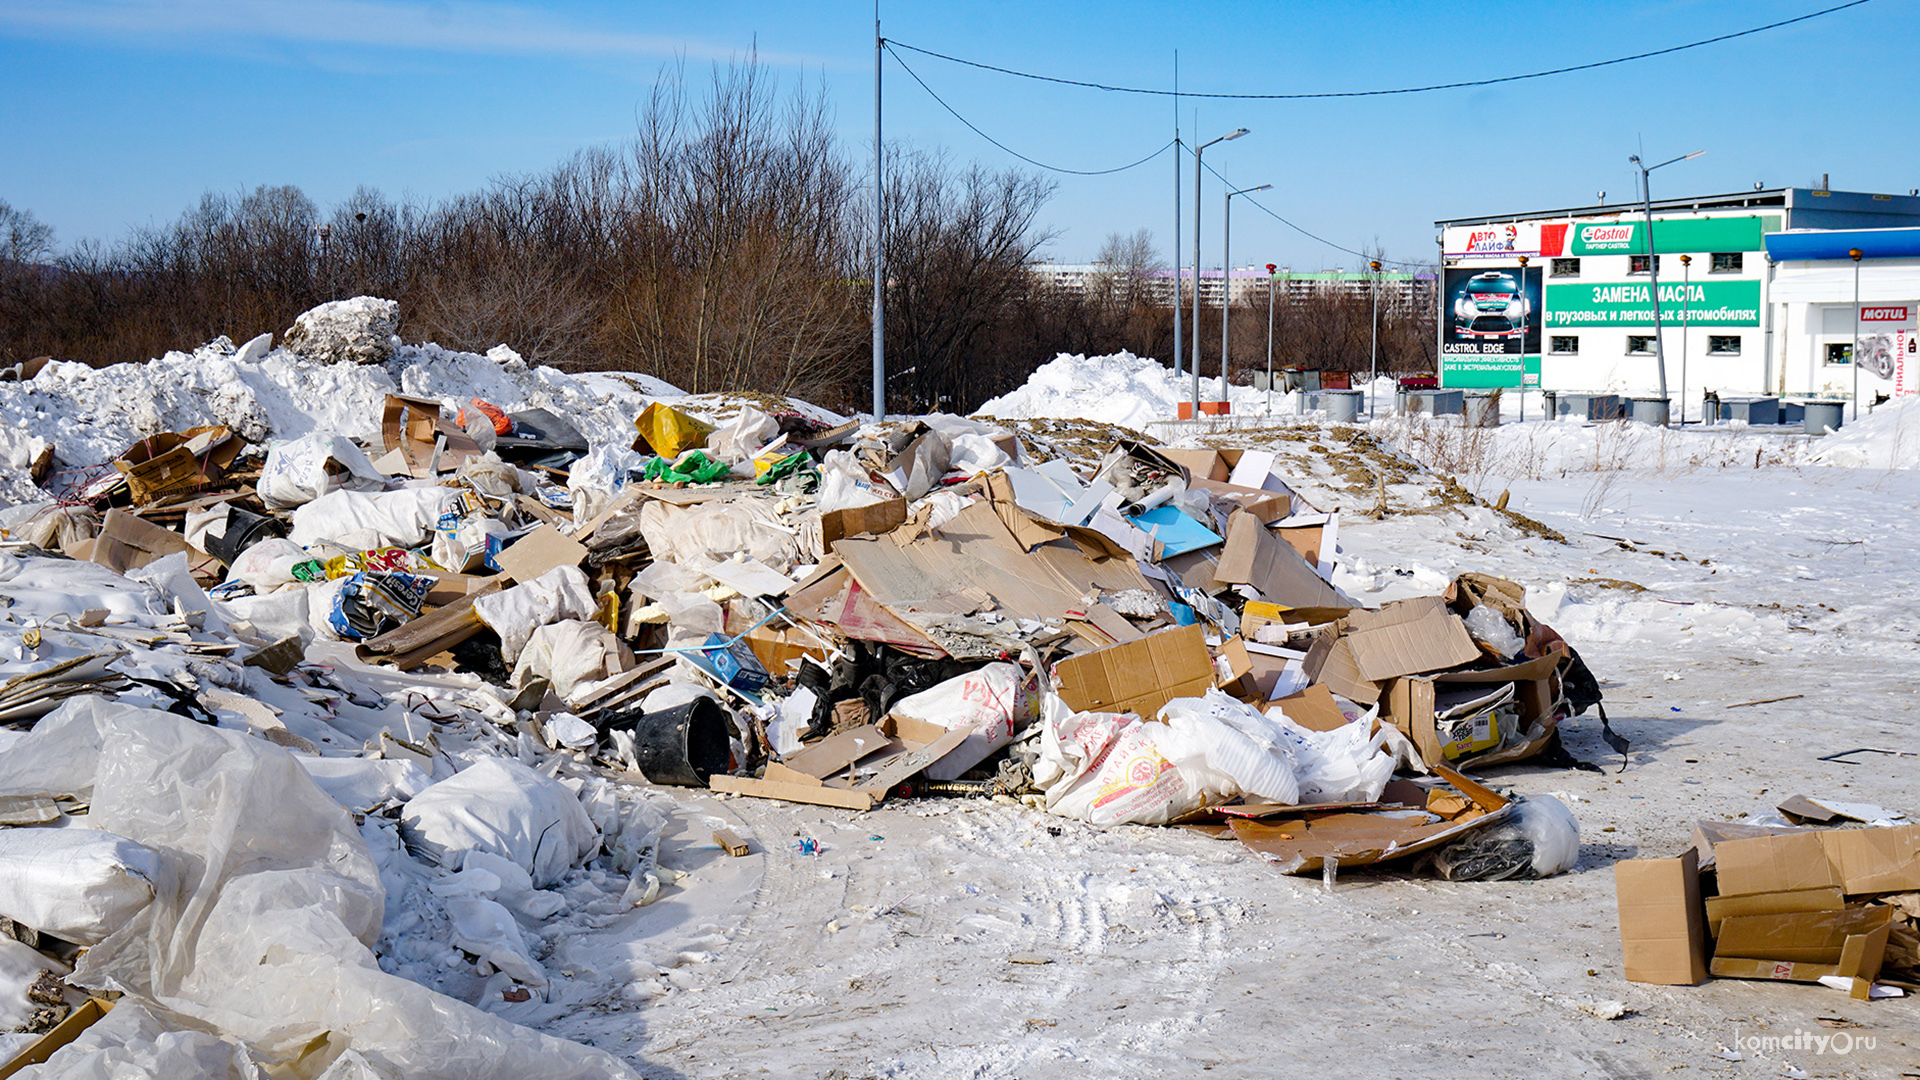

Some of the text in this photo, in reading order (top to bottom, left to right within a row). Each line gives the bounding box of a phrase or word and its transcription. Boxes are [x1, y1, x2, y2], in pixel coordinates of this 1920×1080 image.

[1593, 227, 1630, 240] Castrol
[1592, 285, 1705, 303] ЗАМЕНА МАСЛА
[1555, 311, 1608, 324] грузовых
[1609, 311, 1617, 321] и
[1677, 306, 1757, 321] автомобилях
[1863, 308, 1905, 319] MOTUL
[1443, 343, 1505, 354] CASTROL EDGE
[385, 575, 418, 606] Ceresit
[928, 783, 985, 793] UNIVERSAL
